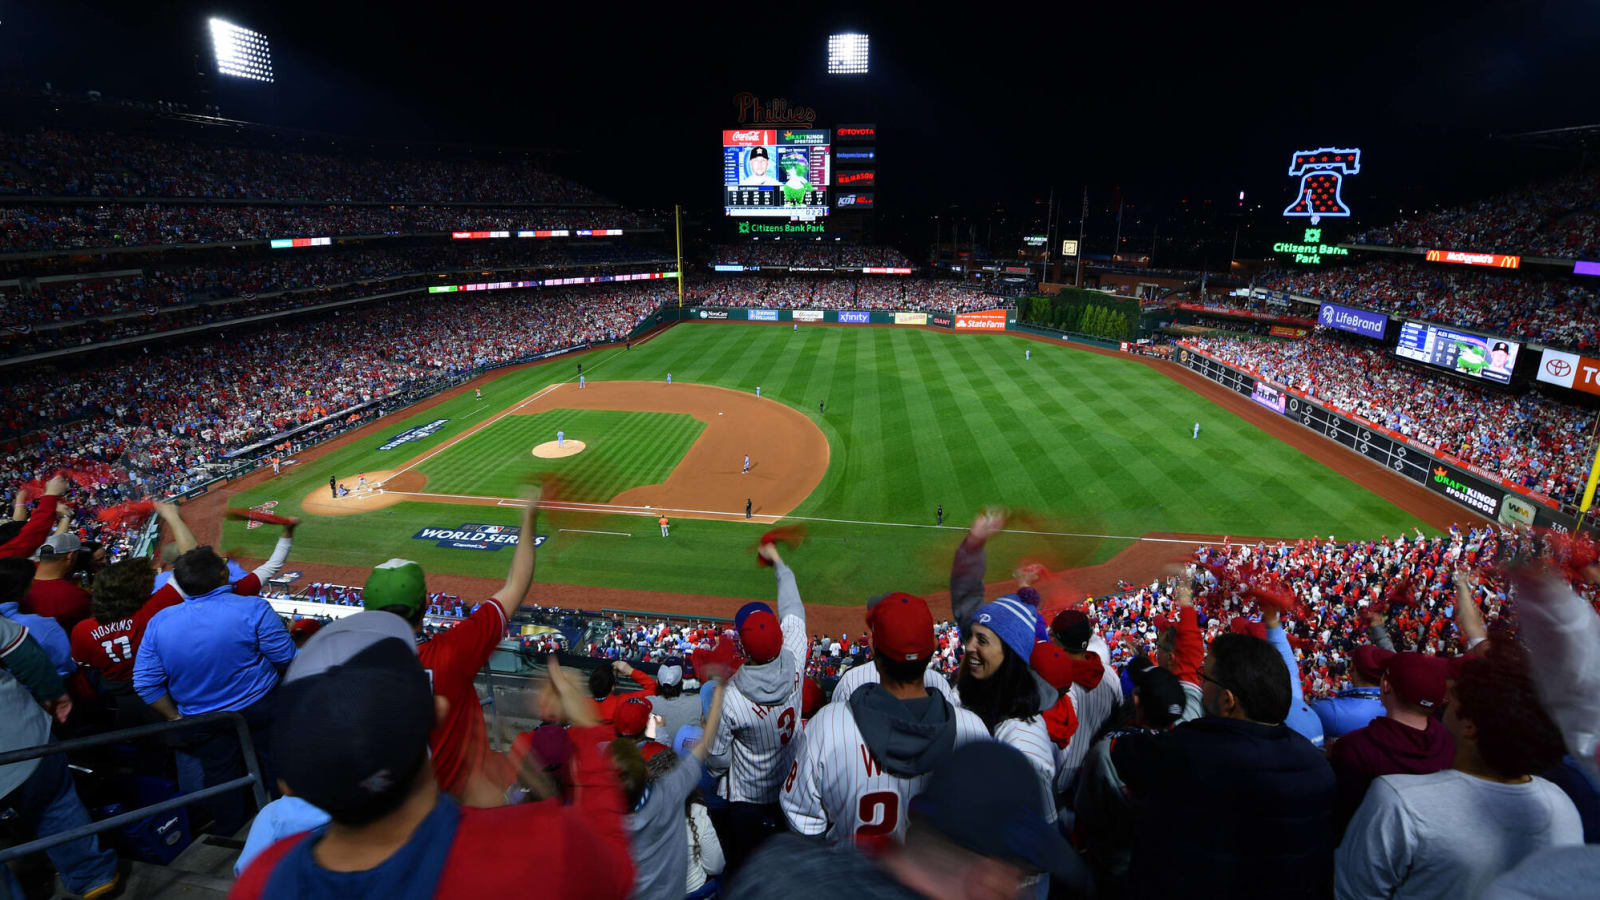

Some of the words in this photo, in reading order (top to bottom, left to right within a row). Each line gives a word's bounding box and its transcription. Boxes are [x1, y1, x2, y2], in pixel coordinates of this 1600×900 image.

[733, 91, 816, 123] Phillies
[847, 128, 875, 136] TOYOTA
[751, 223, 783, 232] Citizens
[784, 223, 805, 232] Bank
[806, 223, 825, 232] Park
[1273, 242, 1317, 254] Citizens
[1319, 244, 1349, 256] Bank
[1295, 254, 1321, 264] Park
[1446, 251, 1494, 264] McDonald's
[840, 313, 868, 322] xfinity
[934, 317, 951, 325] GIANT
[968, 319, 987, 328] State
[987, 320, 1005, 328] Farm
[1335, 311, 1383, 332] LifeBrand
[1434, 474, 1497, 507] DRAFTKINGS
[1446, 487, 1494, 515] SPORTSBOOK
[421, 528, 485, 541] WORLD
[485, 533, 545, 545] SERS
[91, 619, 133, 640] HOSKINS
[101, 635, 132, 663] 17
[777, 706, 796, 745] 3
